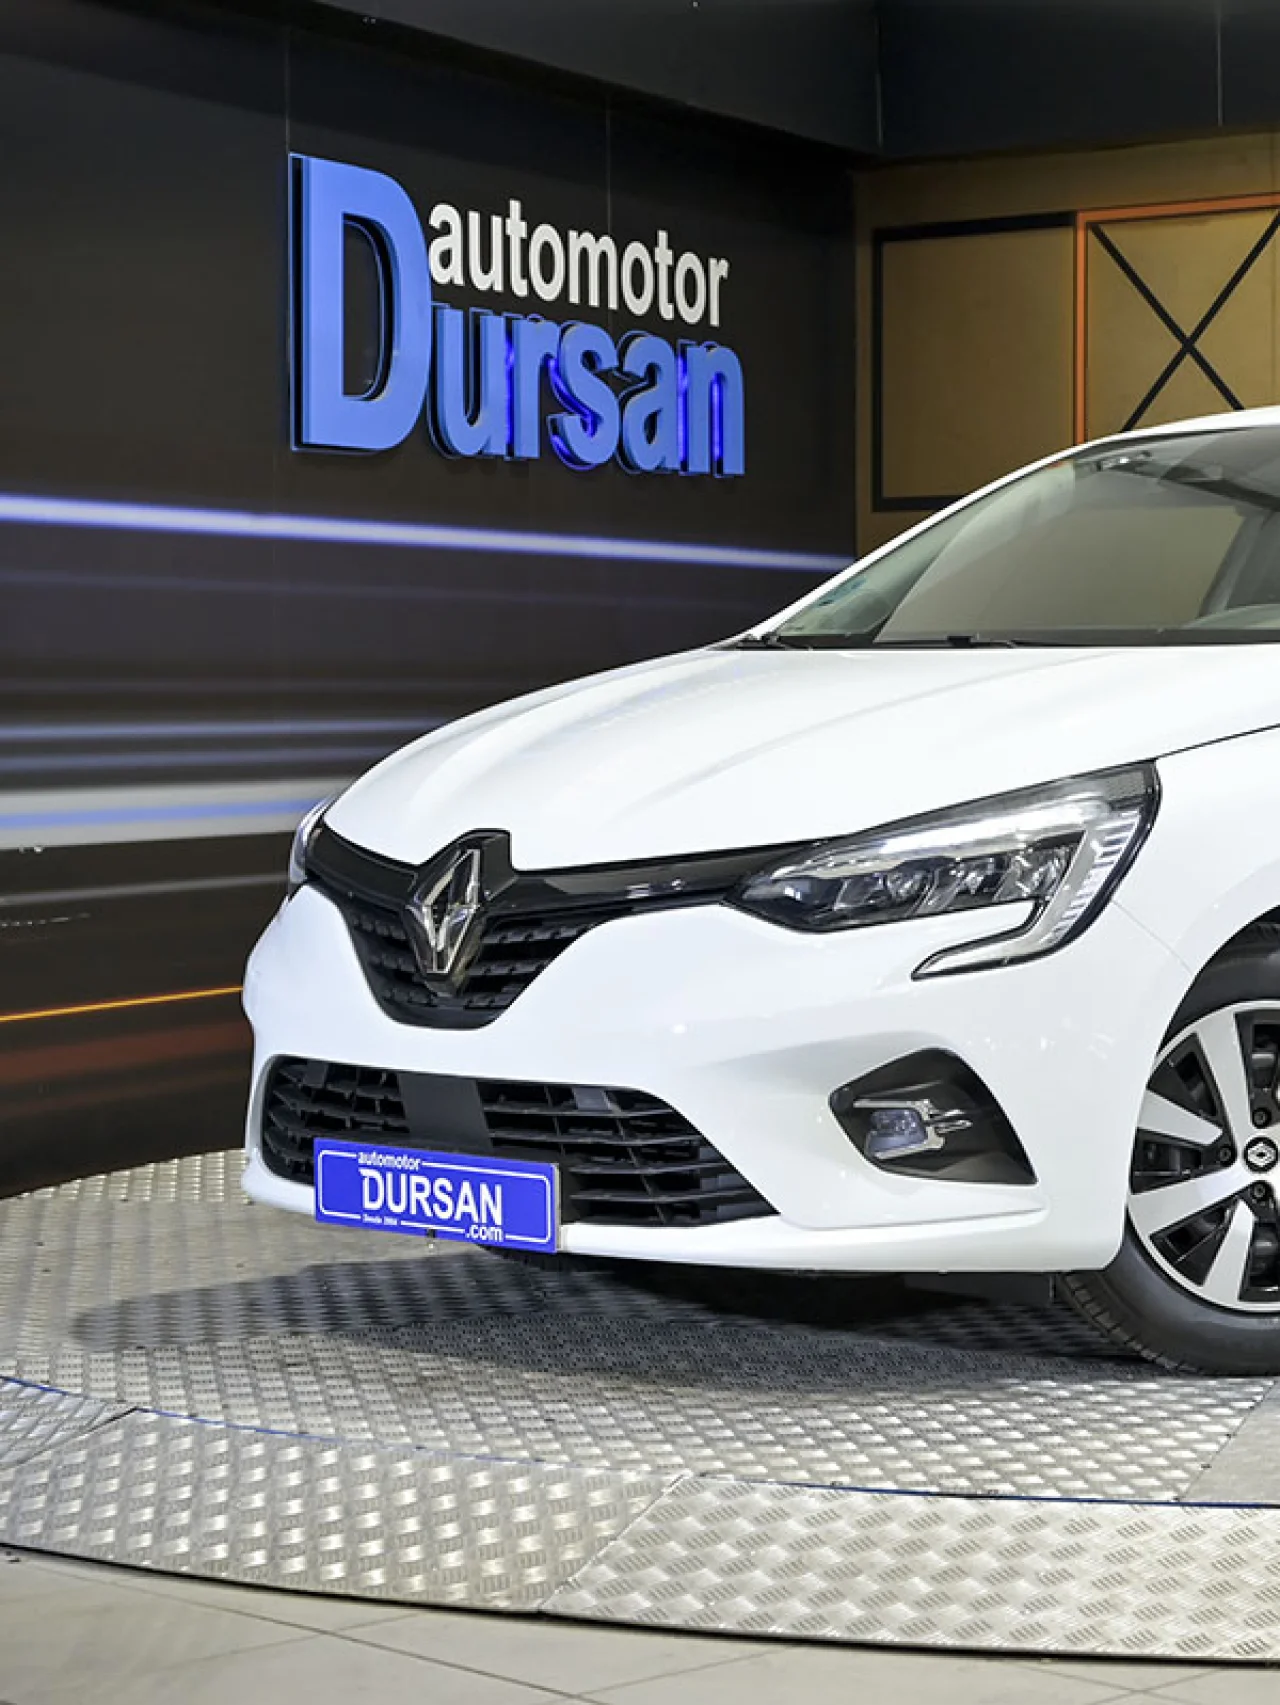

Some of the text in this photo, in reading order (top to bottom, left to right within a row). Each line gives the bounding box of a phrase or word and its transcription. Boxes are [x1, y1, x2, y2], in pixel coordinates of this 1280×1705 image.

[429, 200, 730, 327] automotor
[289, 152, 746, 478] Dursan
[357, 1151, 421, 1171] automotor
[358, 1167, 502, 1226] DURSAN
[464, 1223, 504, 1242] .com
